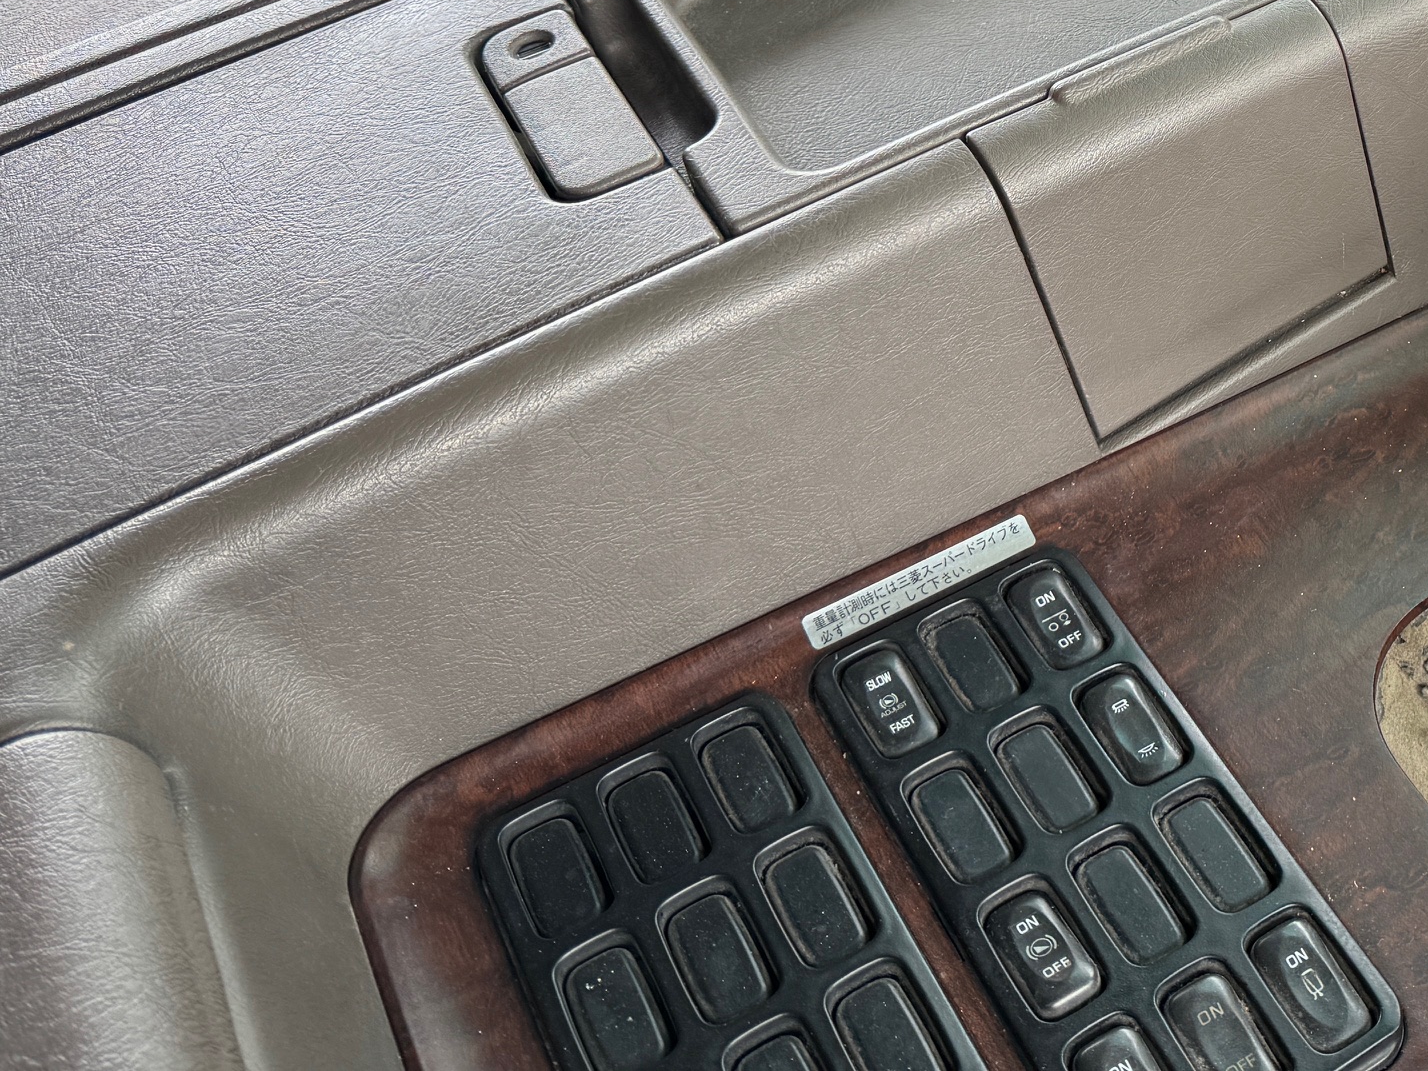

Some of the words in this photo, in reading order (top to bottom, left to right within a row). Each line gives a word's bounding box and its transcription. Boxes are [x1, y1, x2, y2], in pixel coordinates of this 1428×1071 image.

[1035, 590, 1056, 608] ON
[1058, 630, 1082, 648] OFF
[865, 671, 892, 692] SLOW
[880, 700, 907, 719] ADJUST
[889, 714, 915, 734] FAST
[1015, 914, 1040, 935] ON
[1042, 956, 1070, 979] OFF
[1285, 947, 1309, 970] ON
[1197, 1002, 1225, 1026] ON
